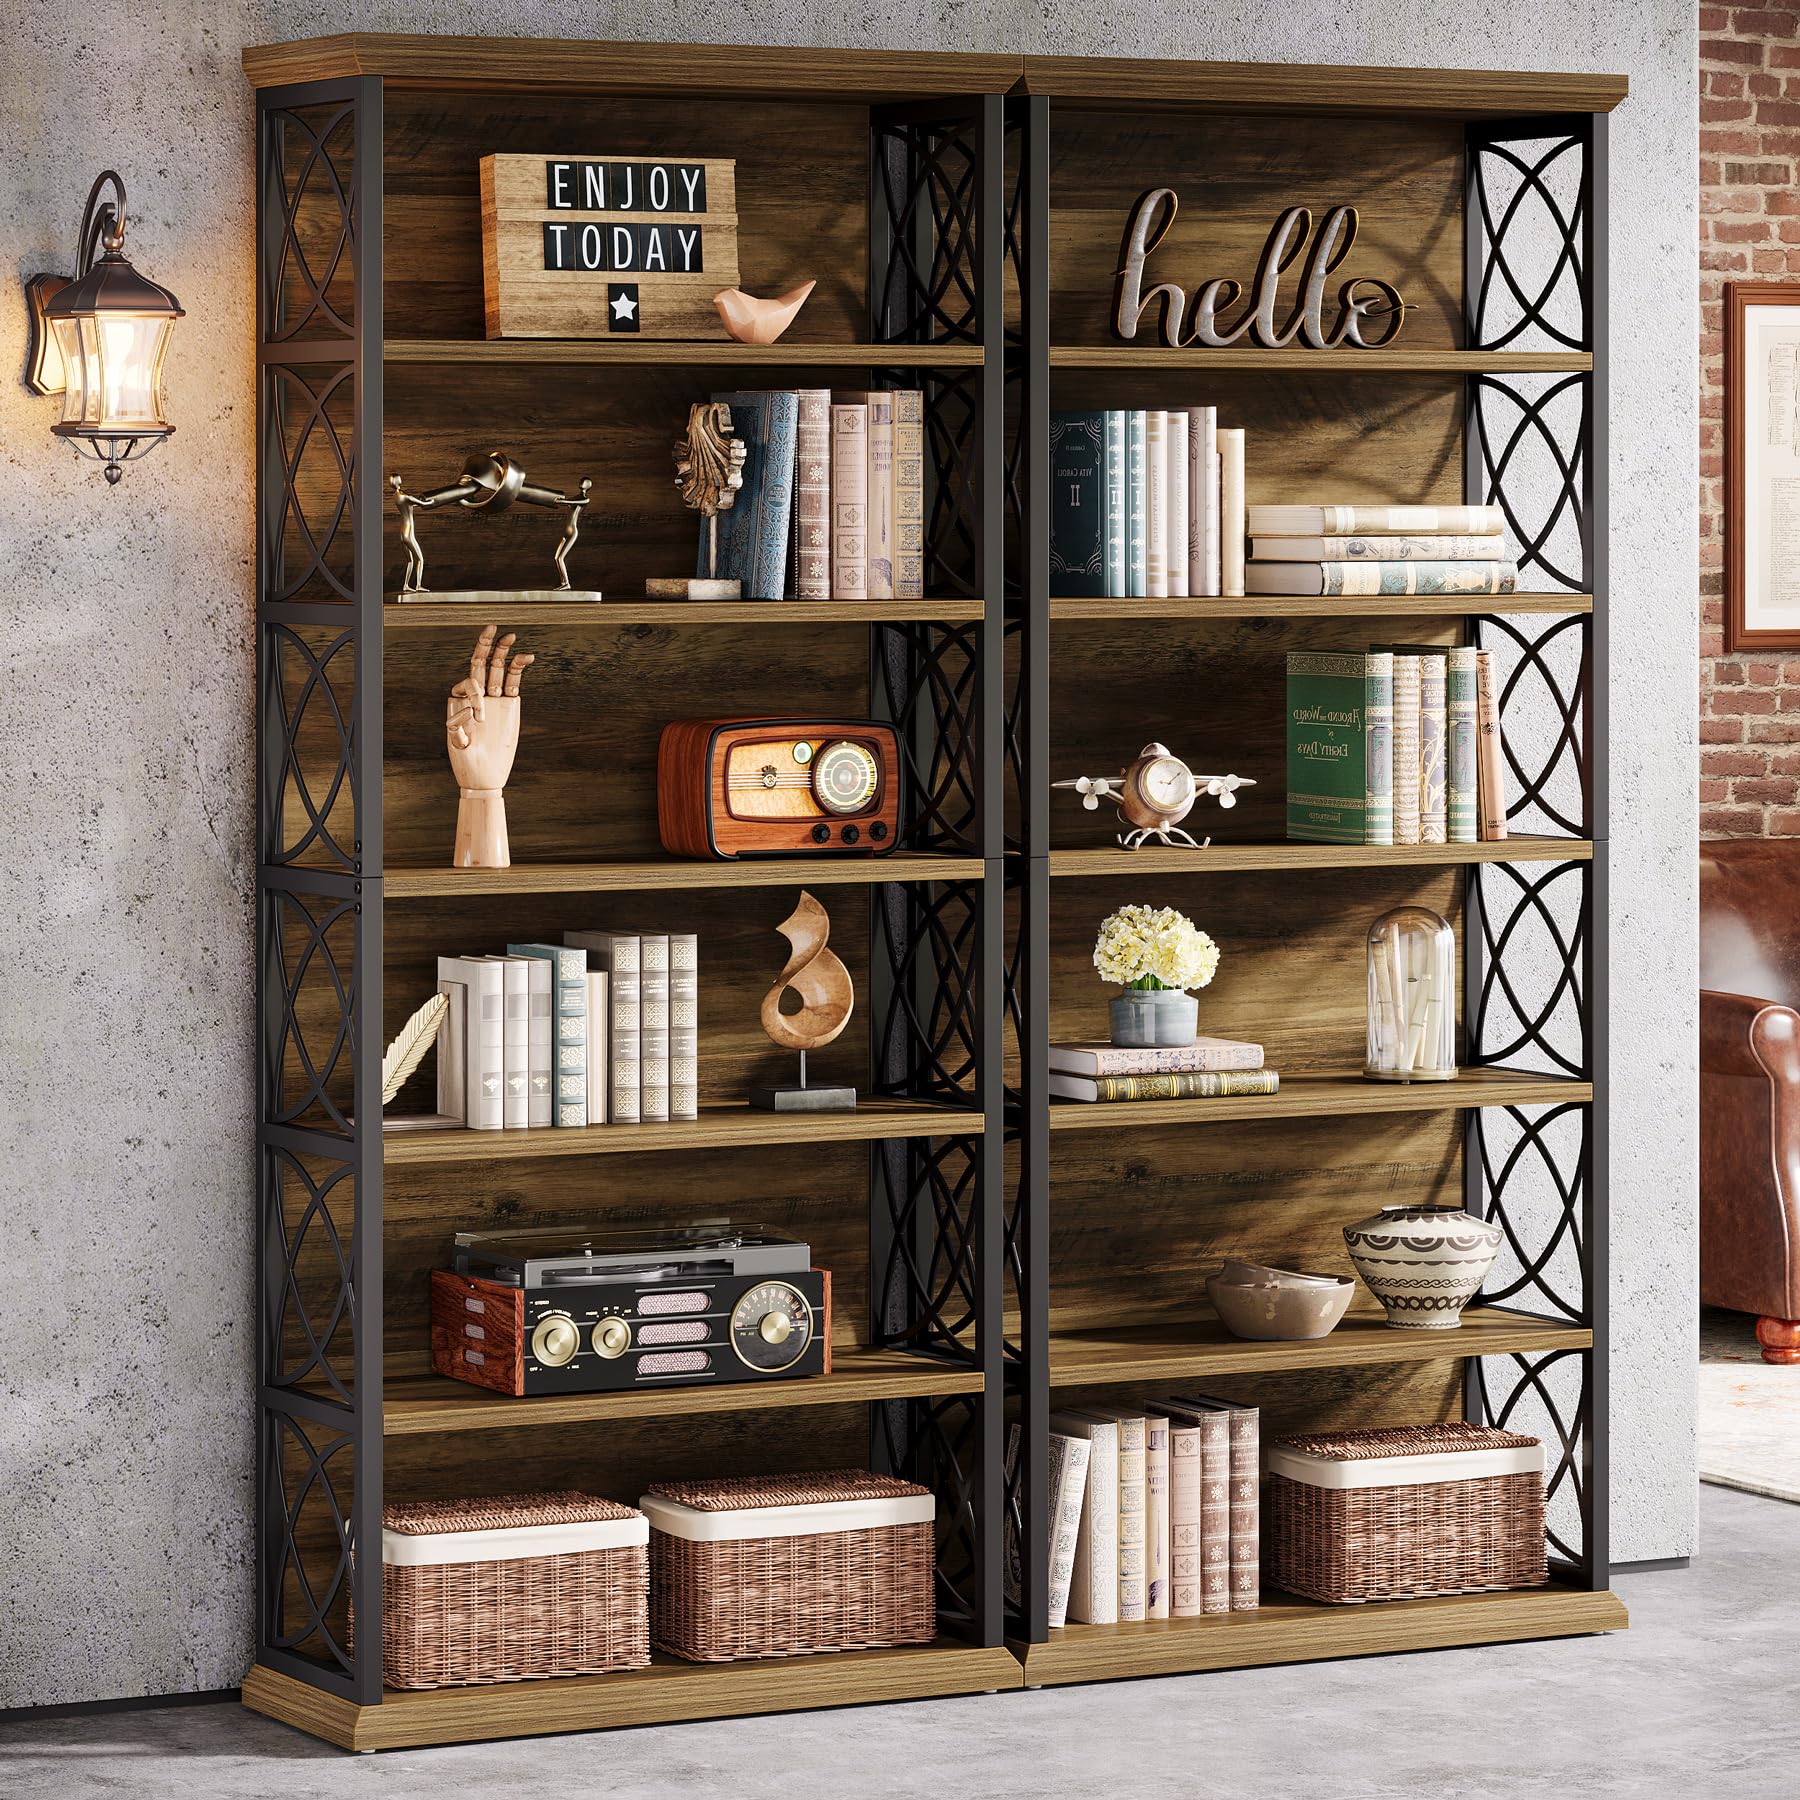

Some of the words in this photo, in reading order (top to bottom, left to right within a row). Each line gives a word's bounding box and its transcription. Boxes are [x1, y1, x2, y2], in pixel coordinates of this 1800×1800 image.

[554, 164, 700, 212] ENJOY
[549, 225, 697, 271] TODAY
[1110, 188, 1419, 349] hello
